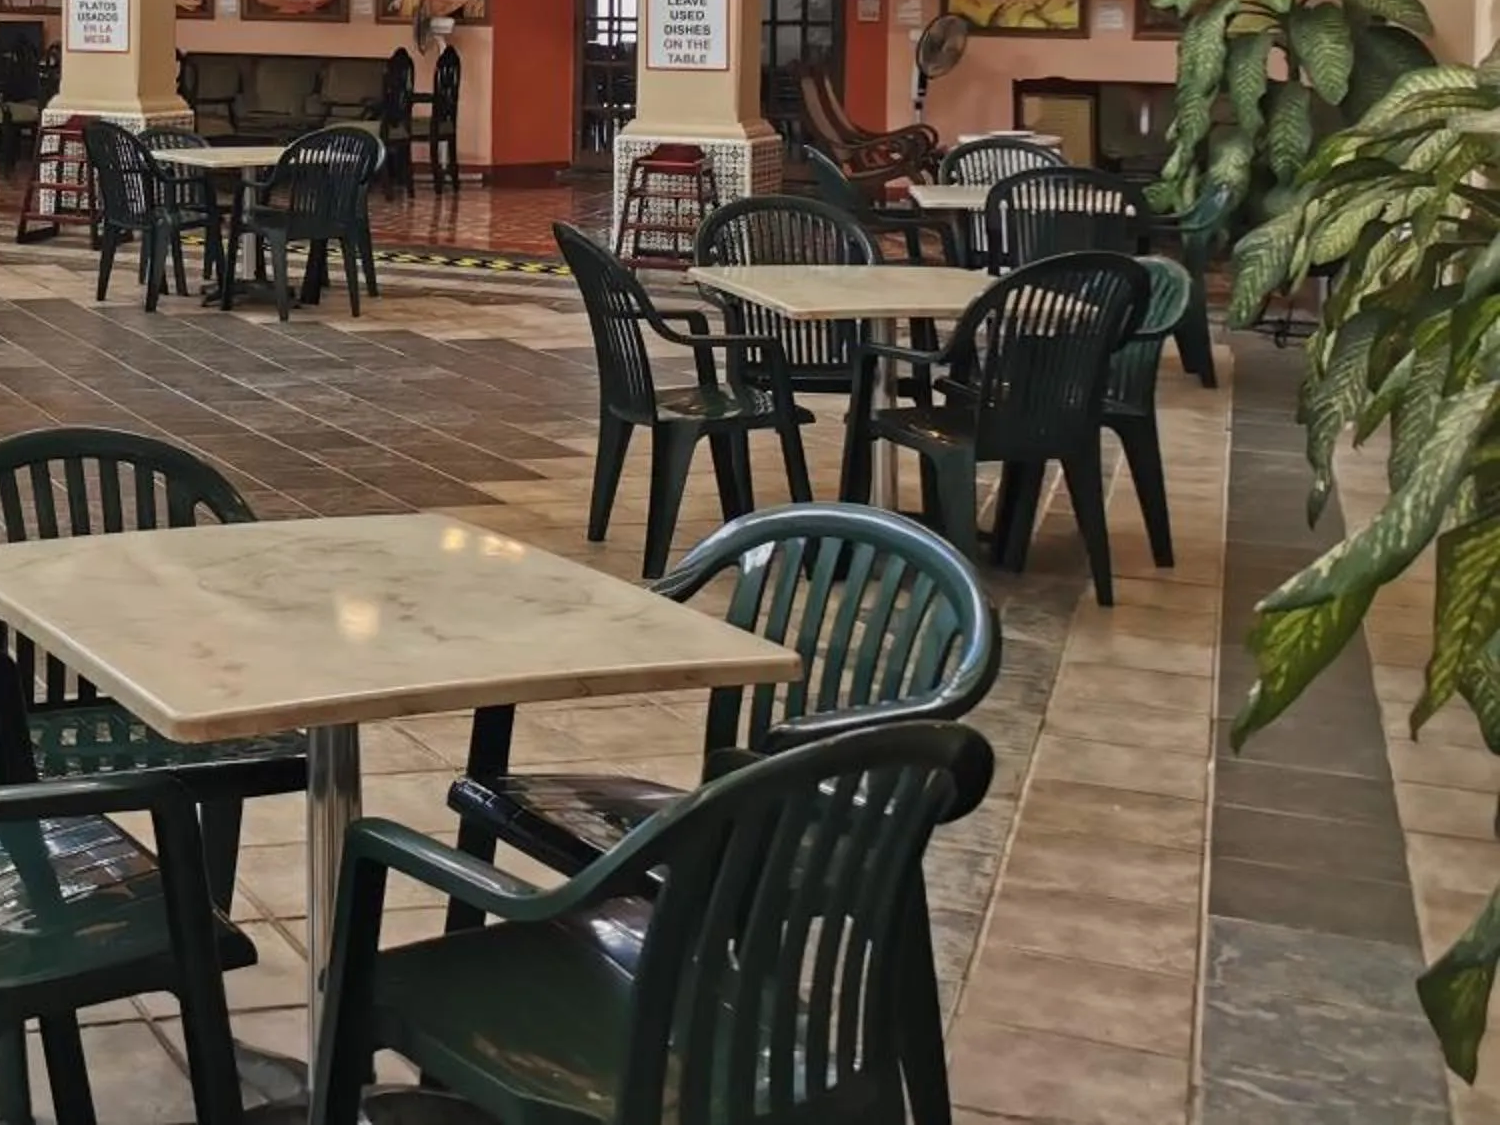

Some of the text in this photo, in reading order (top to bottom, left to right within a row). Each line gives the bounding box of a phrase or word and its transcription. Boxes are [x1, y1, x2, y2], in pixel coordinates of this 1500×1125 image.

[79, 2, 117, 11] PLATOS
[77, 13, 118, 22] USADOS
[669, 11, 705, 21] USED
[83, 24, 112, 33] EN LA
[663, 24, 710, 35] DISHES
[84, 35, 111, 43] MESA
[663, 39, 710, 50] ON THE
[668, 54, 707, 64] TABLE
